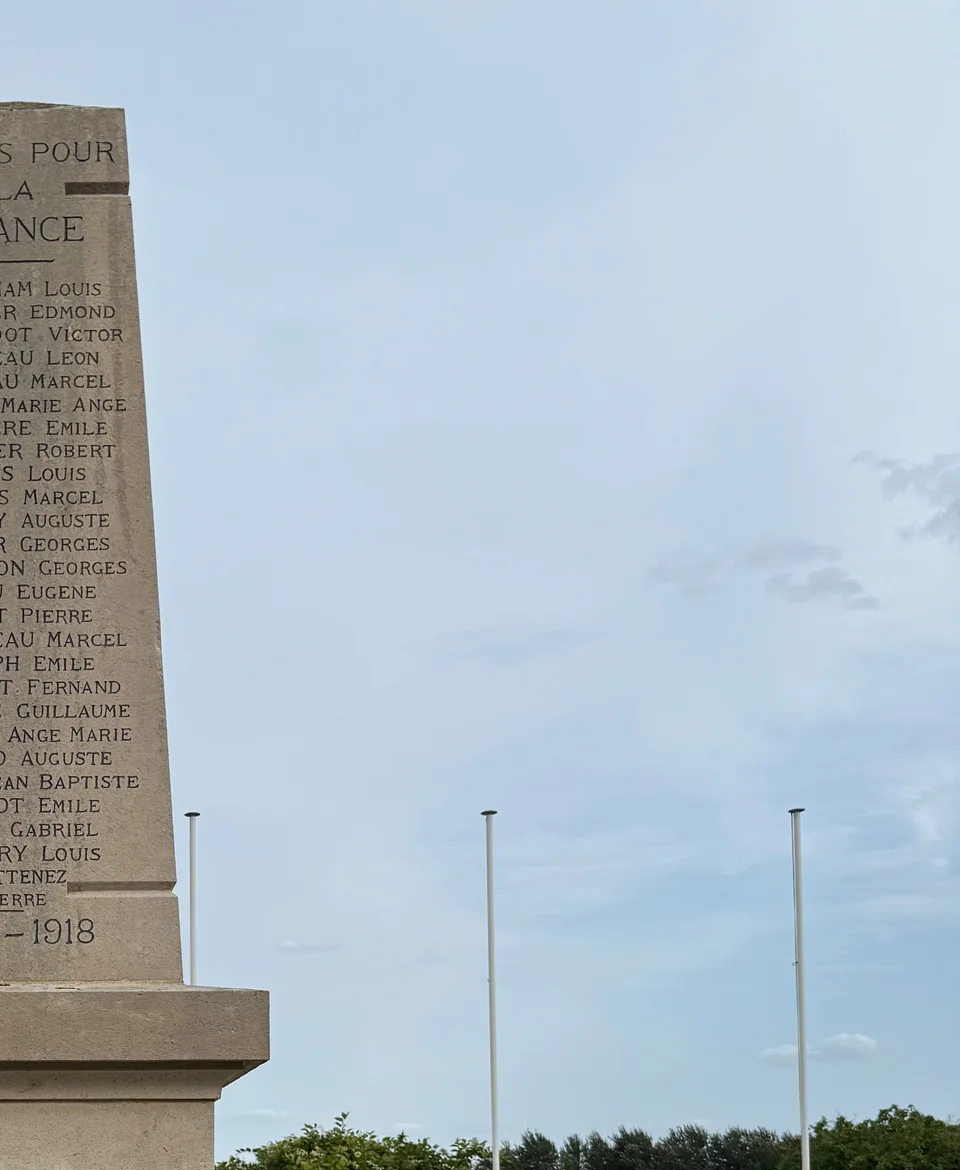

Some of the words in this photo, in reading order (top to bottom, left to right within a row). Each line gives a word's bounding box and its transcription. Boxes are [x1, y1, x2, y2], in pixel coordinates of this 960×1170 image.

[32, 141, 117, 164] POUR
[45, 282, 101, 296] LOUIS
[31, 305, 116, 319] EDMOND
[50, 327, 124, 342] VICTOR
[48, 351, 100, 365] LEON
[31, 375, 111, 389] MARCEL
[2, 398, 61, 413] MARIE
[72, 398, 127, 412] ANGE
[46, 421, 108, 435] EMILE
[36, 444, 116, 458] ROBERT
[28, 467, 86, 482] LOUIS
[23, 490, 103, 505] MARCEL
[21, 513, 110, 528] AUGUSTE
[20, 537, 110, 552] GEORGES
[39, 560, 127, 575] GEORGES
[17, 585, 97, 599] EUGENE
[21, 608, 93, 623] PIERRE
[47, 632, 127, 647] MARCEL
[34, 656, 95, 671] EMILE
[27, 680, 121, 695] FERNAND
[17, 703, 131, 719] GUILLAUME
[8, 727, 60, 742] ANGE
[70, 727, 132, 742] MARIE
[21, 751, 112, 766] AUGUSTE
[40, 775, 140, 789] BAPTISTE
[39, 798, 100, 813] EMILE
[11, 821, 99, 837] GABRIEL
[42, 846, 101, 861] LOUIS
[33, 918, 95, 945] 1918
